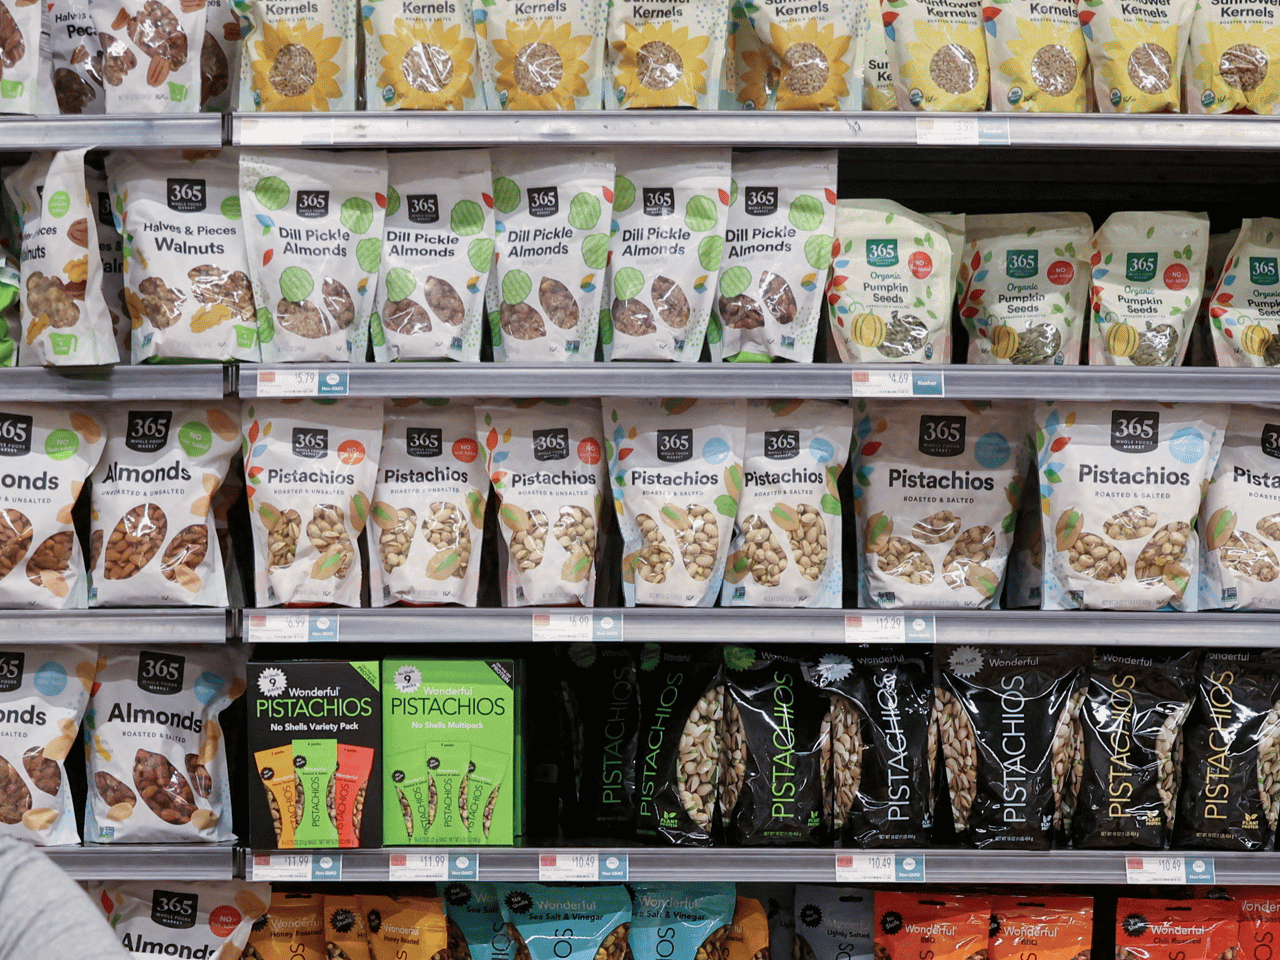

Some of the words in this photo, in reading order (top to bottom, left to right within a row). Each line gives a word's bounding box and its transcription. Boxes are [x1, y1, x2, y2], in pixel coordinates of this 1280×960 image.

[403, 1, 455, 14] Kernels
[300, 195, 325, 207] 365
[279, 227, 301, 240] Dill
[306, 229, 350, 241] Pickle
[283, 242, 346, 257] Almonds
[870, 272, 901, 281] Organic
[863, 282, 909, 297] Pumpkin
[873, 293, 903, 303] Seeds
[1112, 418, 1153, 438] 365
[268, 468, 354, 484] Pistachios
[1079, 464, 1190, 485] Pistachios
[1095, 491, 1131, 499] ROASTED
[989, 657, 1038, 666] Wonderful
[269, 678, 276, 687] 9
[289, 687, 340, 696] Wonderful
[257, 698, 372, 717] PISTACHIOS
[392, 698, 504, 715] PISTACHIOS
[108, 703, 202, 733] Almonds
[270, 723, 283, 731] No
[310, 723, 338, 732] Variety
[340, 722, 358, 730] Pack
[998, 676, 1029, 822] PISTACHIOS
[285, 856, 308, 867] $11.99
[868, 857, 891, 868] $10.49
[156, 898, 192, 916] 365
[571, 912, 603, 922] Vinegar
[906, 923, 957, 938] Wonderful
